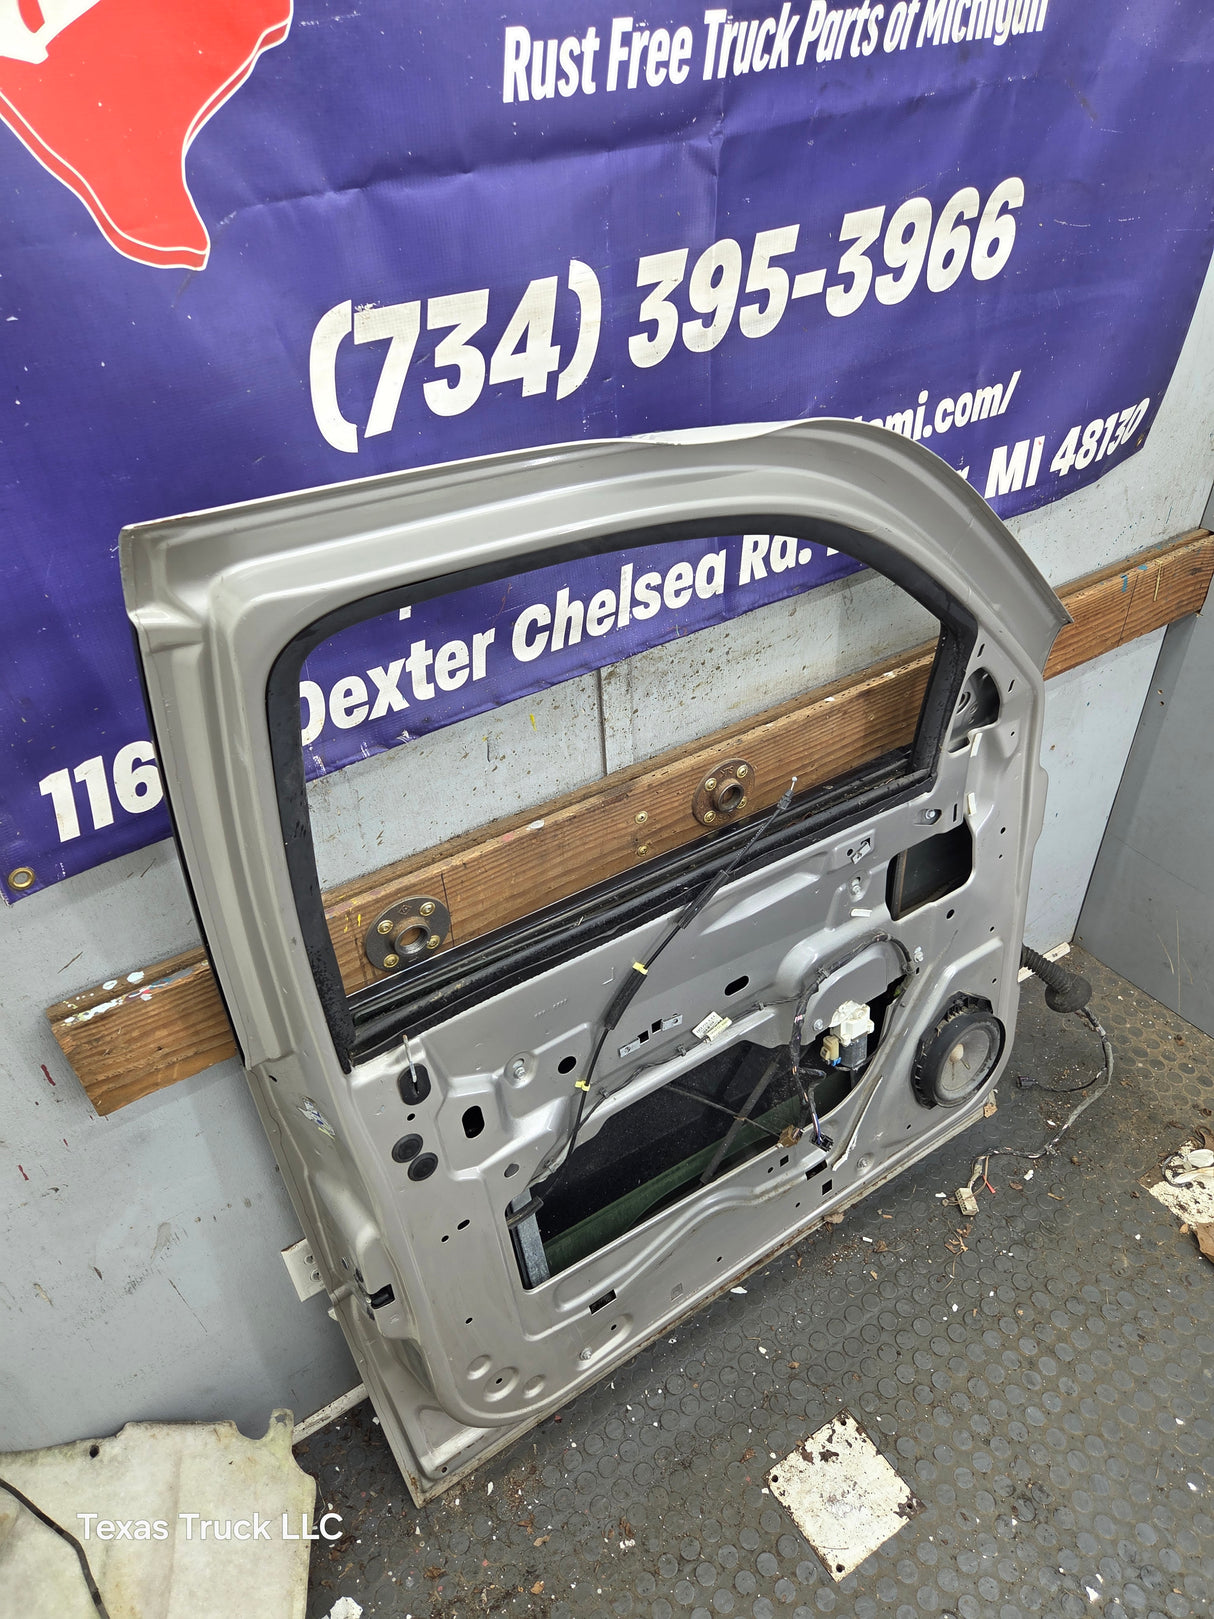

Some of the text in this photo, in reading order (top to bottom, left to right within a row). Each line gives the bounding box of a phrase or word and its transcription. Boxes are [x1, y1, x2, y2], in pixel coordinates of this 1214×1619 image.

[503, 0, 1049, 104] Rust Free Truck Parts of Michigan
[309, 179, 1025, 454] (734) 395-3966
[855, 369, 1022, 441] mi.com/
[511, 548, 727, 663] Chelsea
[983, 435, 1046, 500] MI
[1049, 396, 1151, 477] 48130
